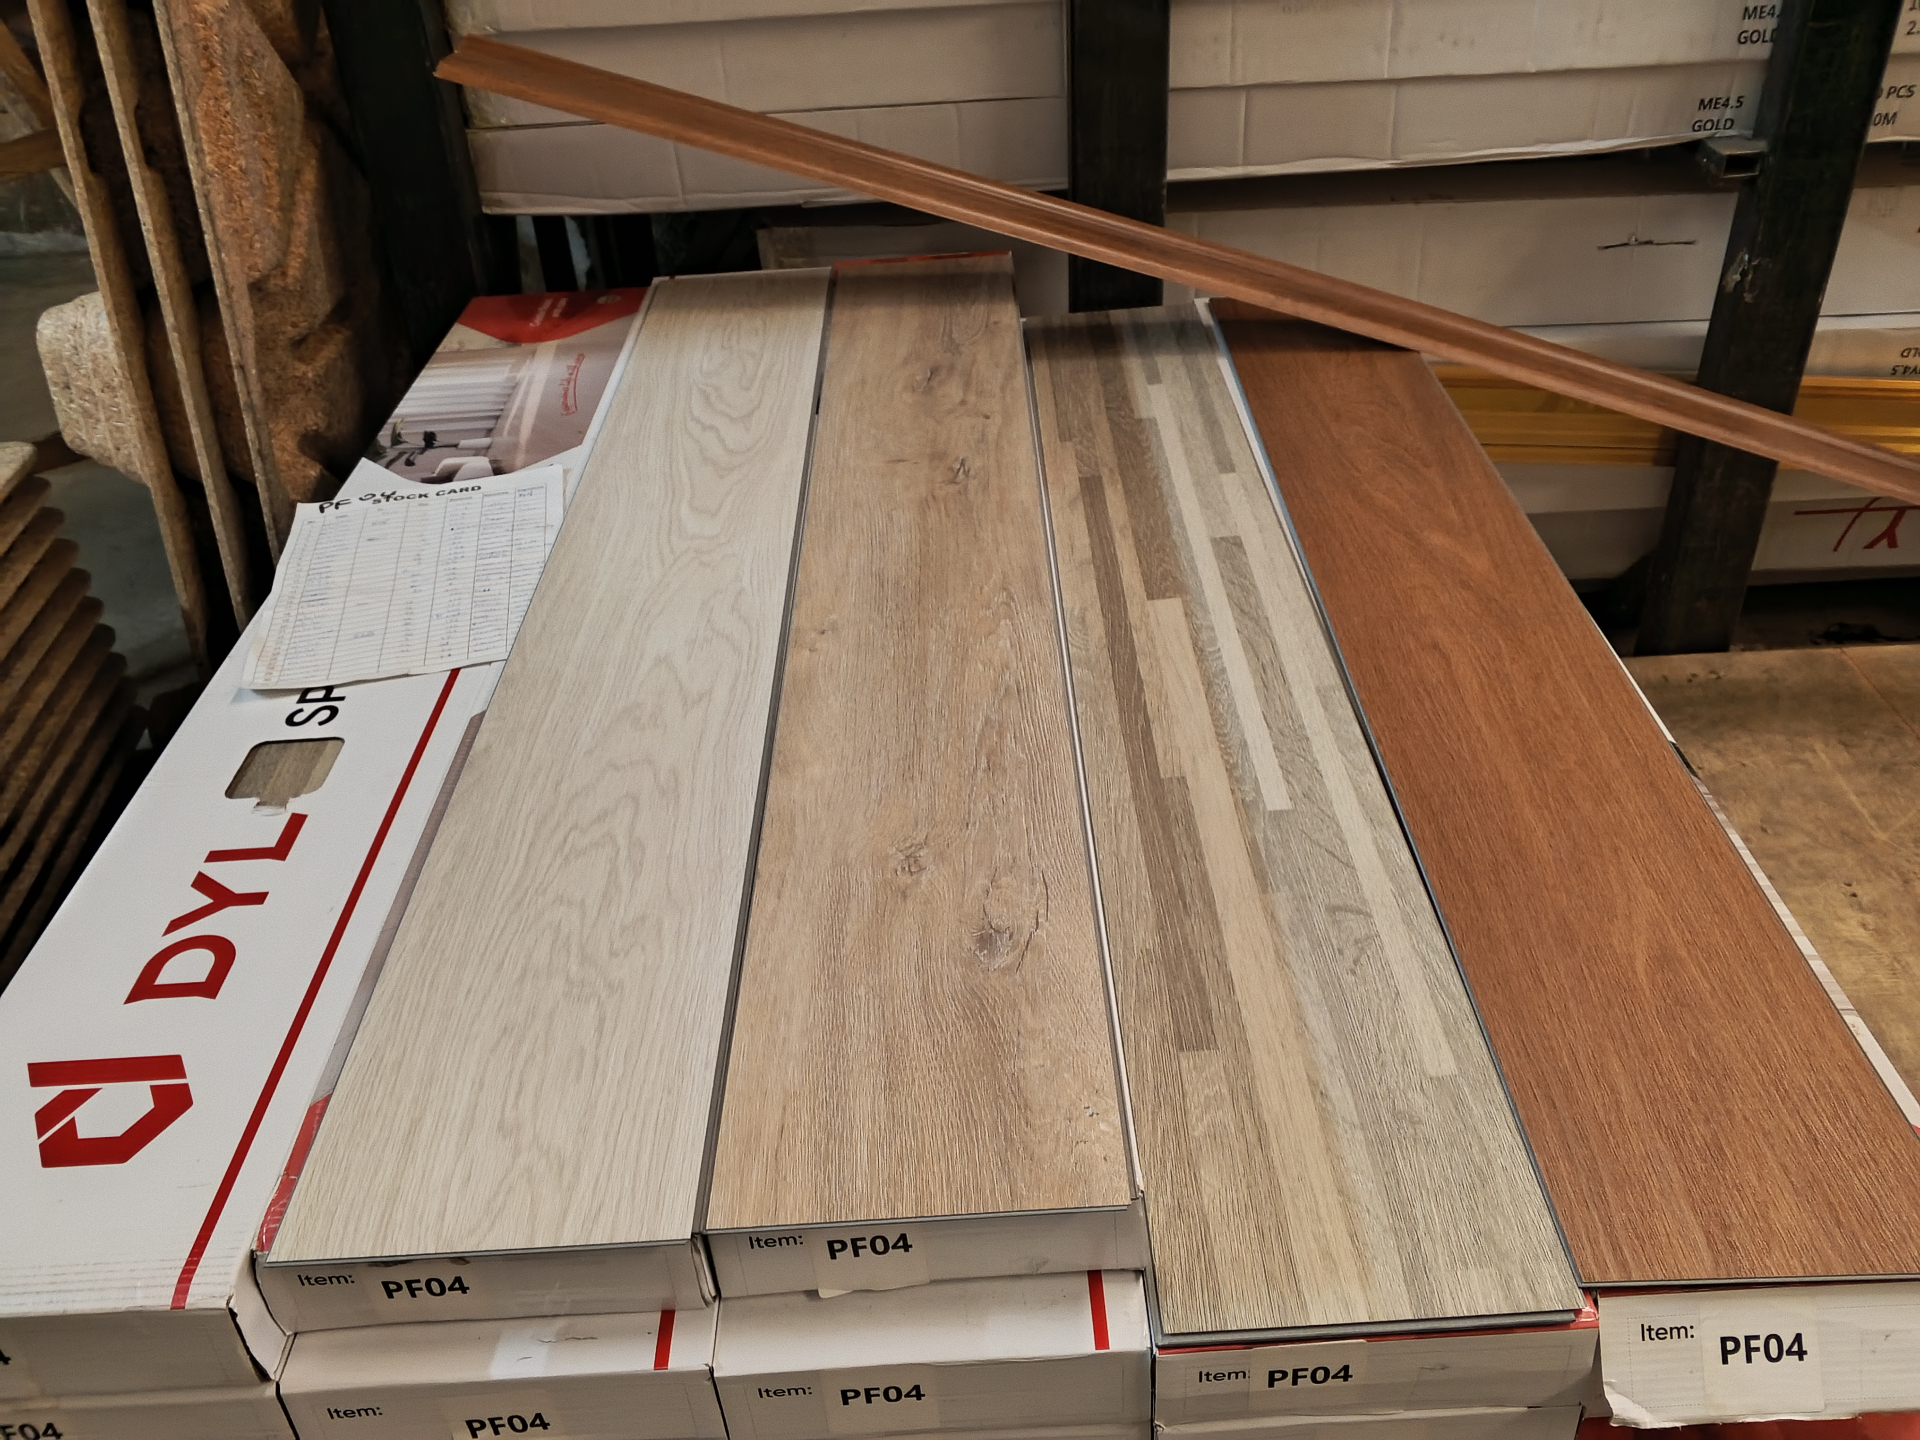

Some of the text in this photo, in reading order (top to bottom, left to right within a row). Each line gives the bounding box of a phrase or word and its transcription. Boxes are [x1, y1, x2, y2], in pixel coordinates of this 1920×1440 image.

[1886, 84, 1915, 98] PCS
[1698, 95, 1745, 111] ME4.5
[1692, 118, 1735, 132] GOLD
[1900, 347, 1920, 359] LD
[372, 485, 483, 504] STOCK CARD
[318, 498, 352, 514] PF
[123, 812, 309, 1005] DYL
[749, 1233, 913, 1260] Item: PF04
[297, 1274, 470, 1300] Item: PF04
[1640, 1323, 1808, 1365] Item: PF04
[1267, 1364, 1354, 1389] PF04
[757, 1384, 926, 1406] Item: PF04
[326, 1405, 551, 1439] Item: PF04
